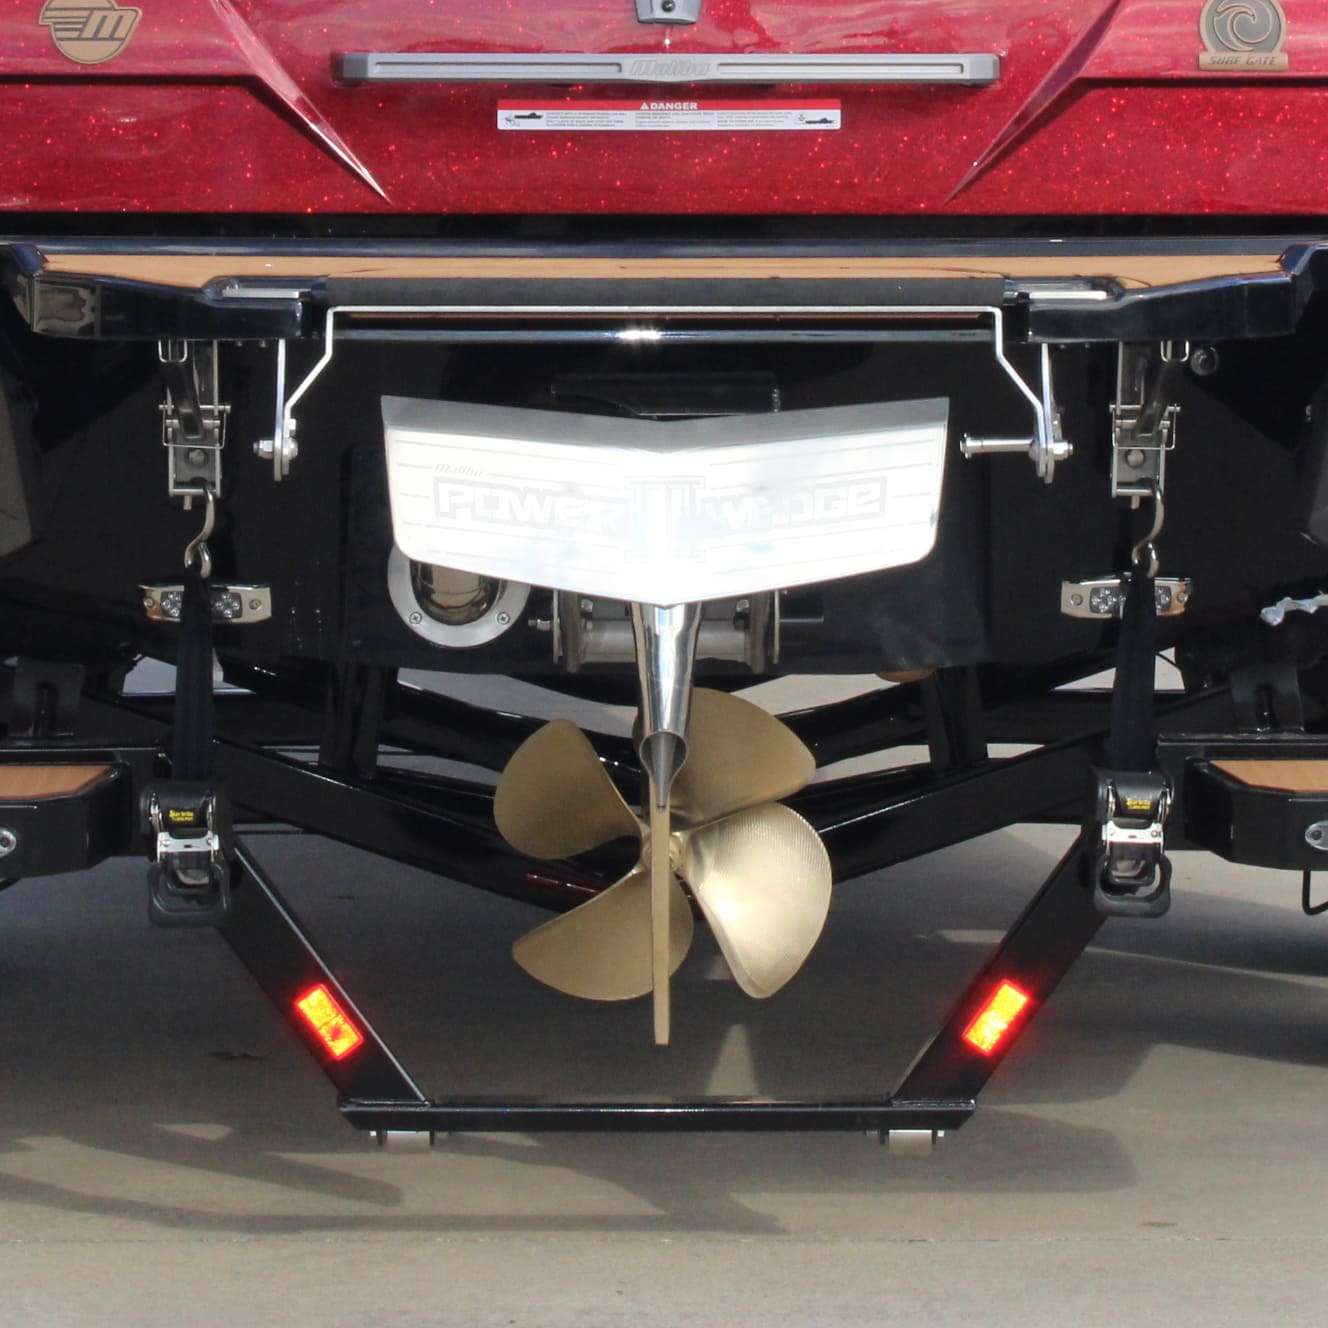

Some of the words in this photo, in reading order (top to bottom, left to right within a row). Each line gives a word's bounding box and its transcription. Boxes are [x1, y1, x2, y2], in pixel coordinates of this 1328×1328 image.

[1208, 55, 1241, 65] SURF
[1246, 55, 1278, 65] GATE
[650, 102, 699, 111] DANGER
[438, 480, 622, 540] POWER
